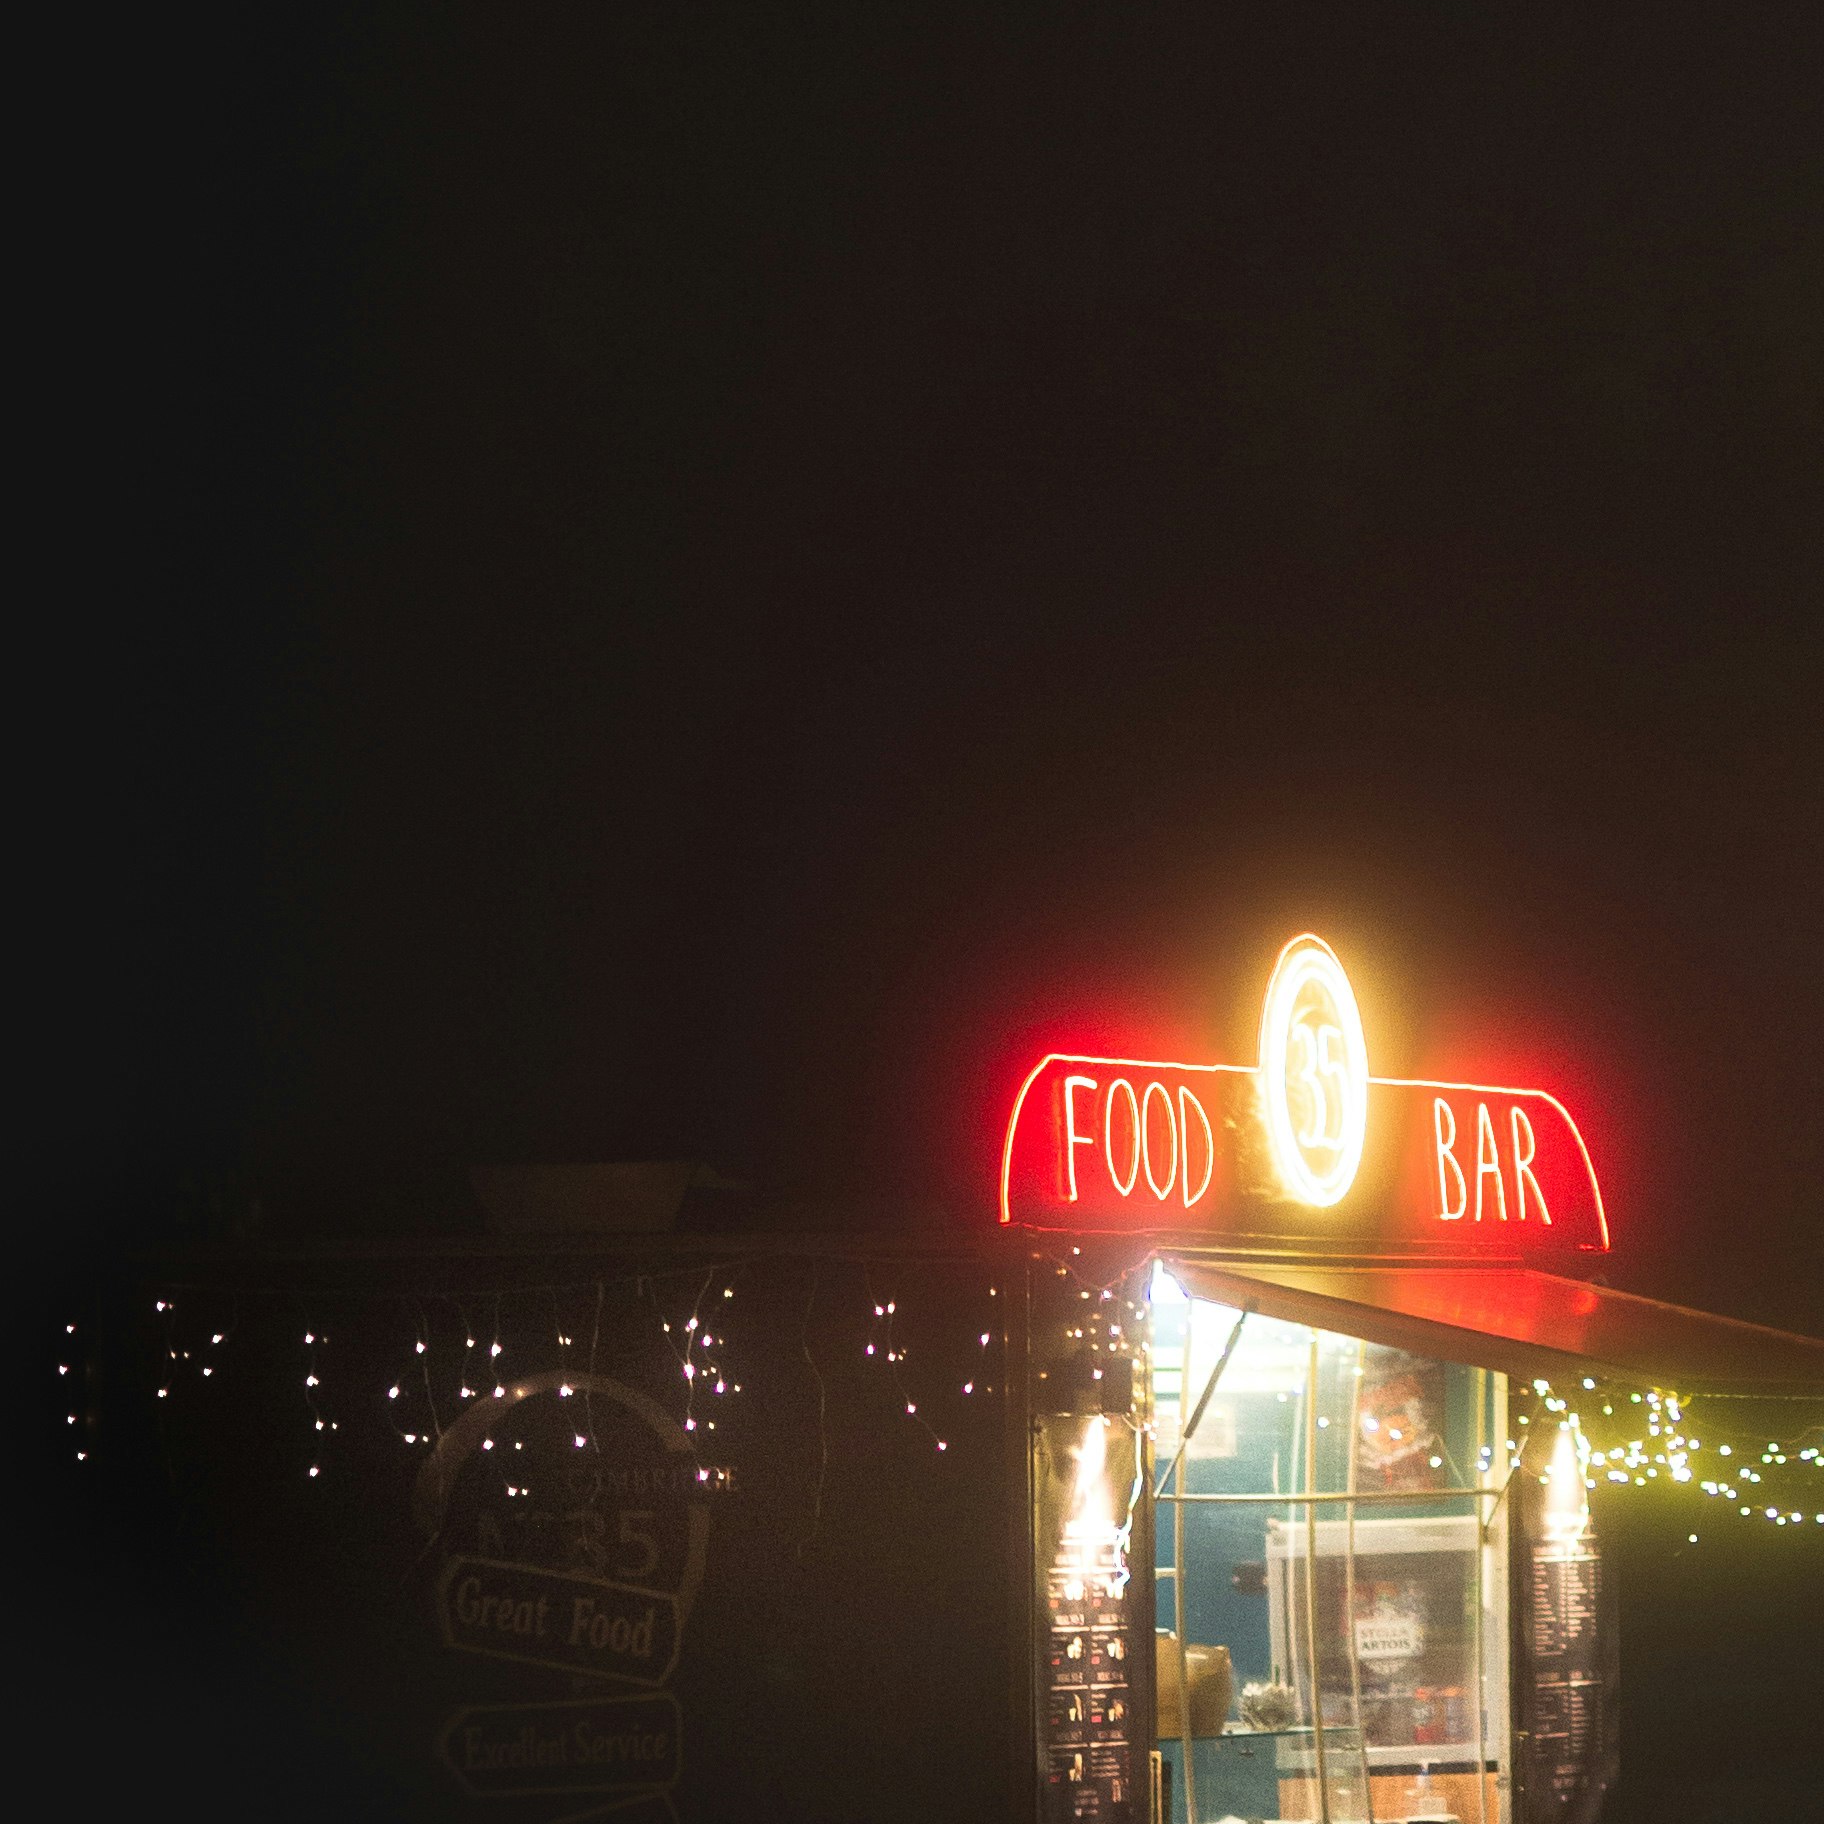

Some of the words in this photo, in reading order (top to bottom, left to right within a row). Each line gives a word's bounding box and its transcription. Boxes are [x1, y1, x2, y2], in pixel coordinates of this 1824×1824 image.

[1063, 1075, 1214, 1209] FOOD
[1290, 1023, 1347, 1152] 35
[1435, 1097, 1552, 1225] BAR
[456, 1576, 549, 1637] Great
[569, 1596, 655, 1657] Food
[1361, 1639, 1411, 1651] ARTOIS
[464, 1725, 568, 1771] Excellent
[573, 1719, 668, 1763] Service
